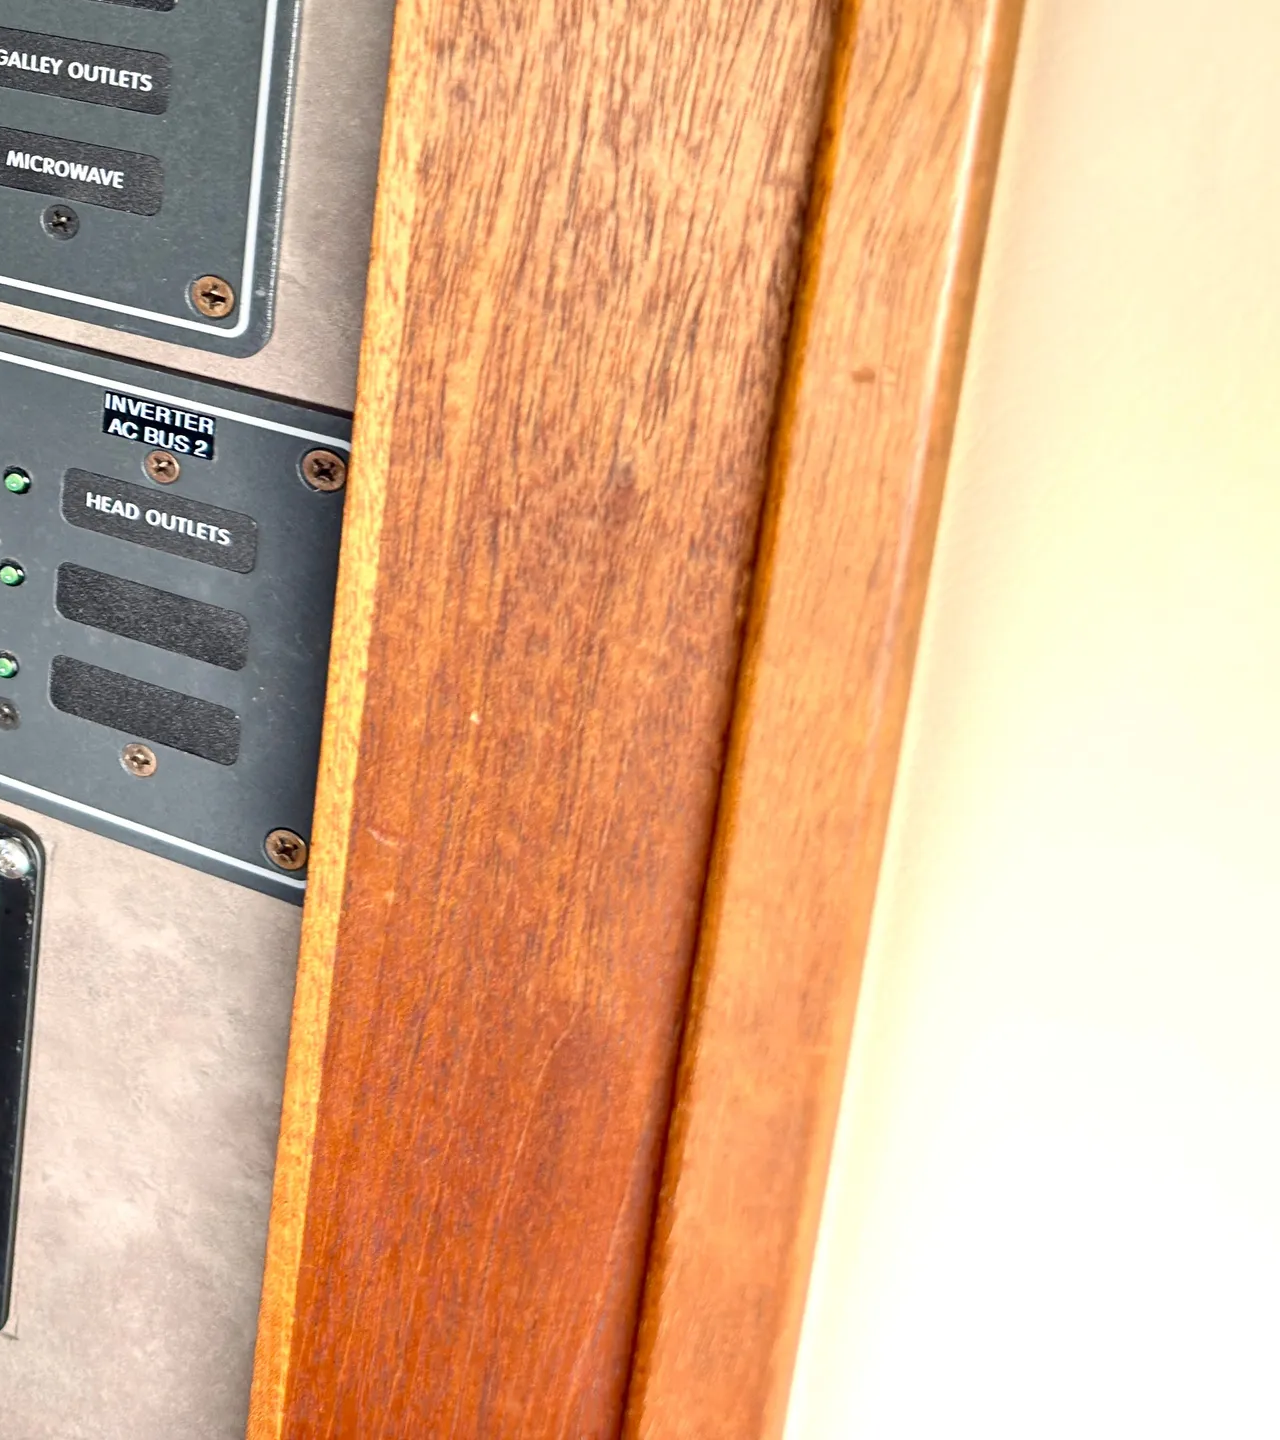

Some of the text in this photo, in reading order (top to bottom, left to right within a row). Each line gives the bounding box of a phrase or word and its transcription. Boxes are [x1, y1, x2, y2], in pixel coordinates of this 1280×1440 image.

[67, 61, 154, 92] OUTLETS
[5, 150, 125, 190] MICROWAVE
[104, 392, 215, 436] INVERTER
[106, 417, 209, 458] AC BUS 2
[87, 493, 231, 545] HEAD OUTLETS
